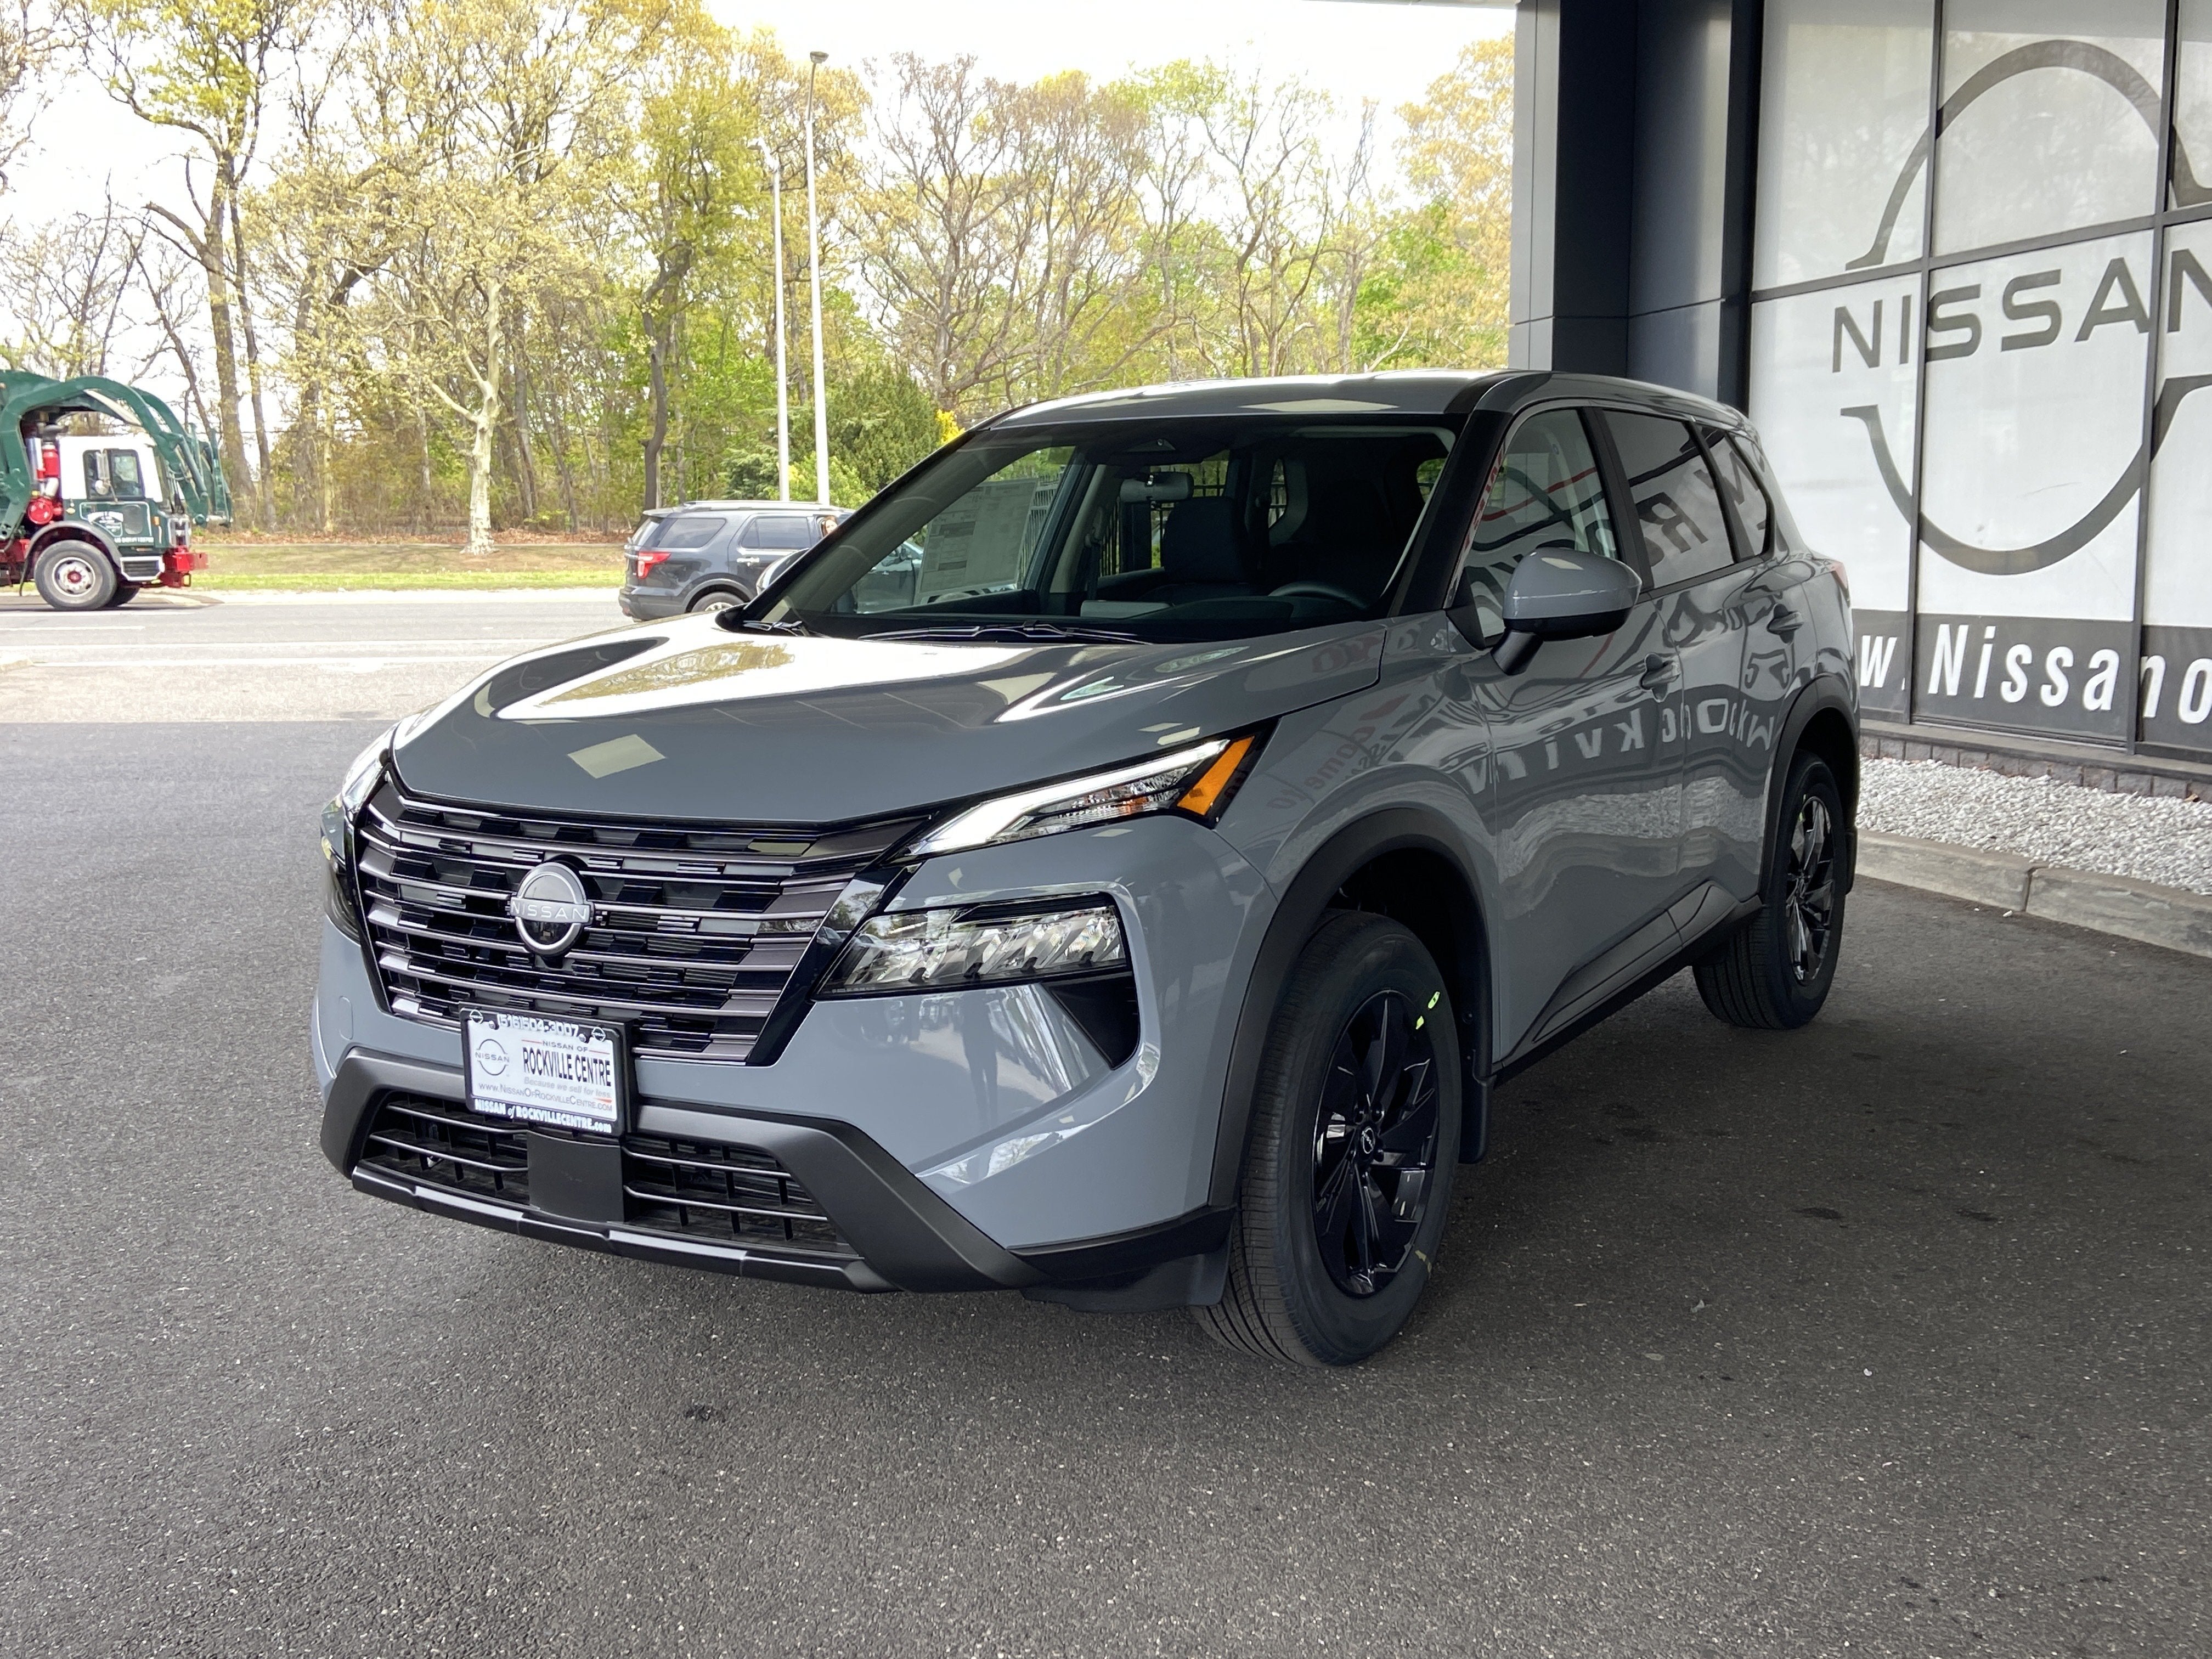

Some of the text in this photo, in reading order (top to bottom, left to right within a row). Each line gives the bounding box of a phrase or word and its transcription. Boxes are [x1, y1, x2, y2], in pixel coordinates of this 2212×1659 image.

[1832, 250, 2212, 373] NISSAN
[511, 901, 586, 919] NISSAN
[543, 1040, 574, 1050] NISSAN
[475, 1051, 510, 1063] NISSAN
[523, 1047, 612, 1087] ROCKVILLE CENTRE
[524, 1077, 555, 1088] Because
[569, 1085, 582, 1093] sell
[584, 1087, 594, 1095] for
[475, 1098, 506, 1115] NISSAN
[507, 1105, 516, 1119] of
